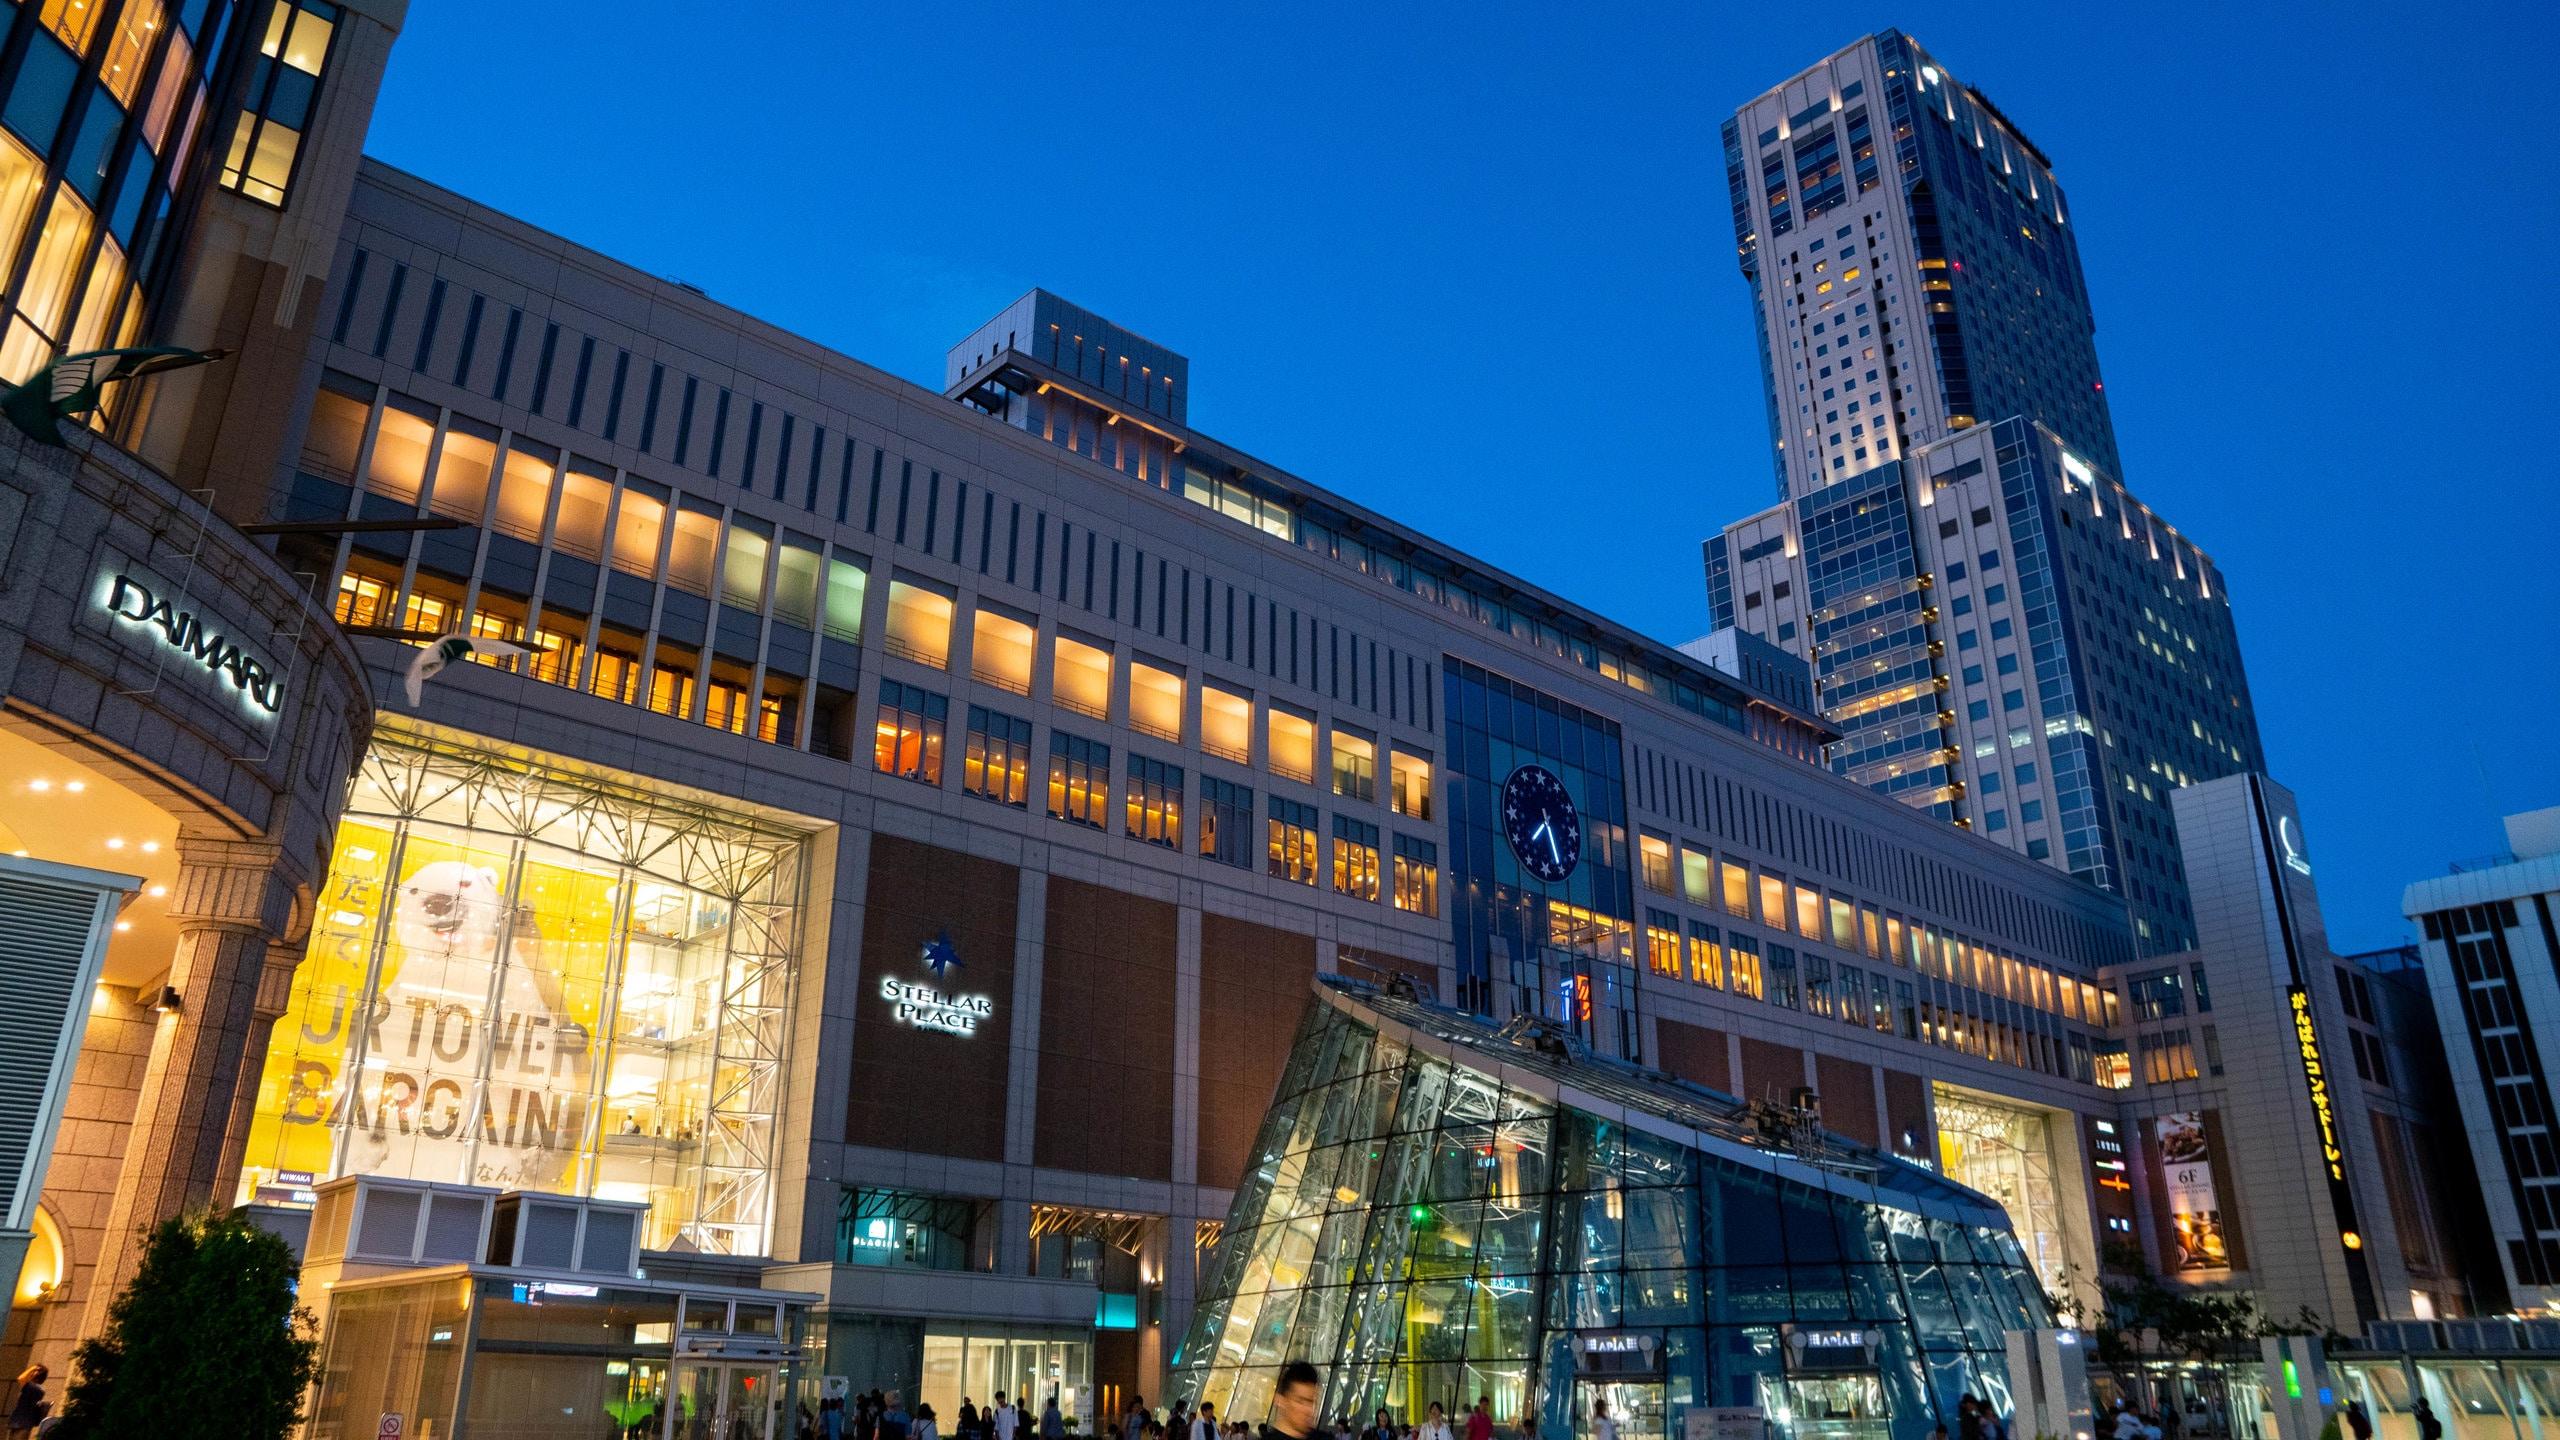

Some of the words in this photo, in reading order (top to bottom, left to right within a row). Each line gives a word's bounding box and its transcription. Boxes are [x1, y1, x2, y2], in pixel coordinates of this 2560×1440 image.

[108, 574, 285, 713] DAIMARU
[885, 980, 992, 1014] STELLAR
[302, 984, 391, 1053] JR
[899, 1002, 977, 1031] PLACE
[284, 1058, 563, 1150] BARGAIN
[279, 1173, 311, 1183] NIWAKA
[2178, 1168, 2198, 1184] 6F
